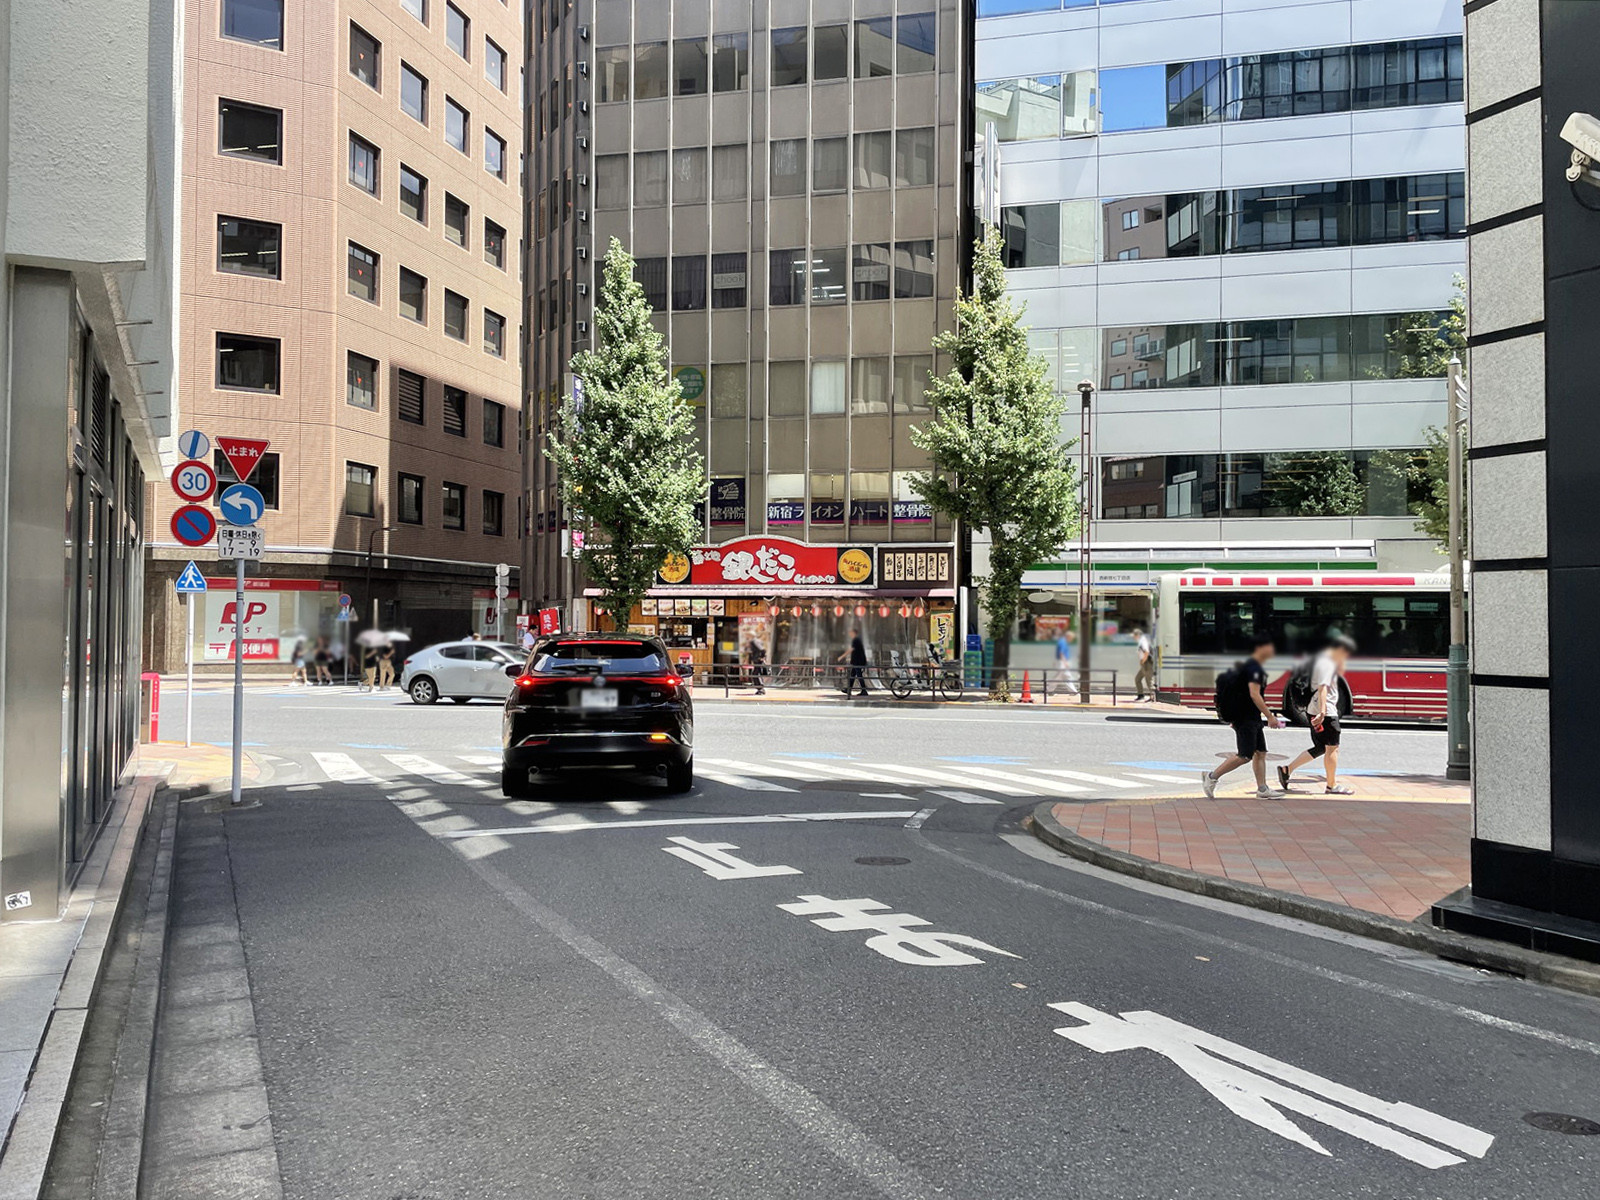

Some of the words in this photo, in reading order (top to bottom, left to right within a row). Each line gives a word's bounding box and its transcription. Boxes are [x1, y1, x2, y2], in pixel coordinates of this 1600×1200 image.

[228, 446, 259, 457] 止まれ
[182, 471, 207, 491] 30
[721, 545, 795, 583] 銀だこ
[662, 837, 1495, 1169] 止まれ
